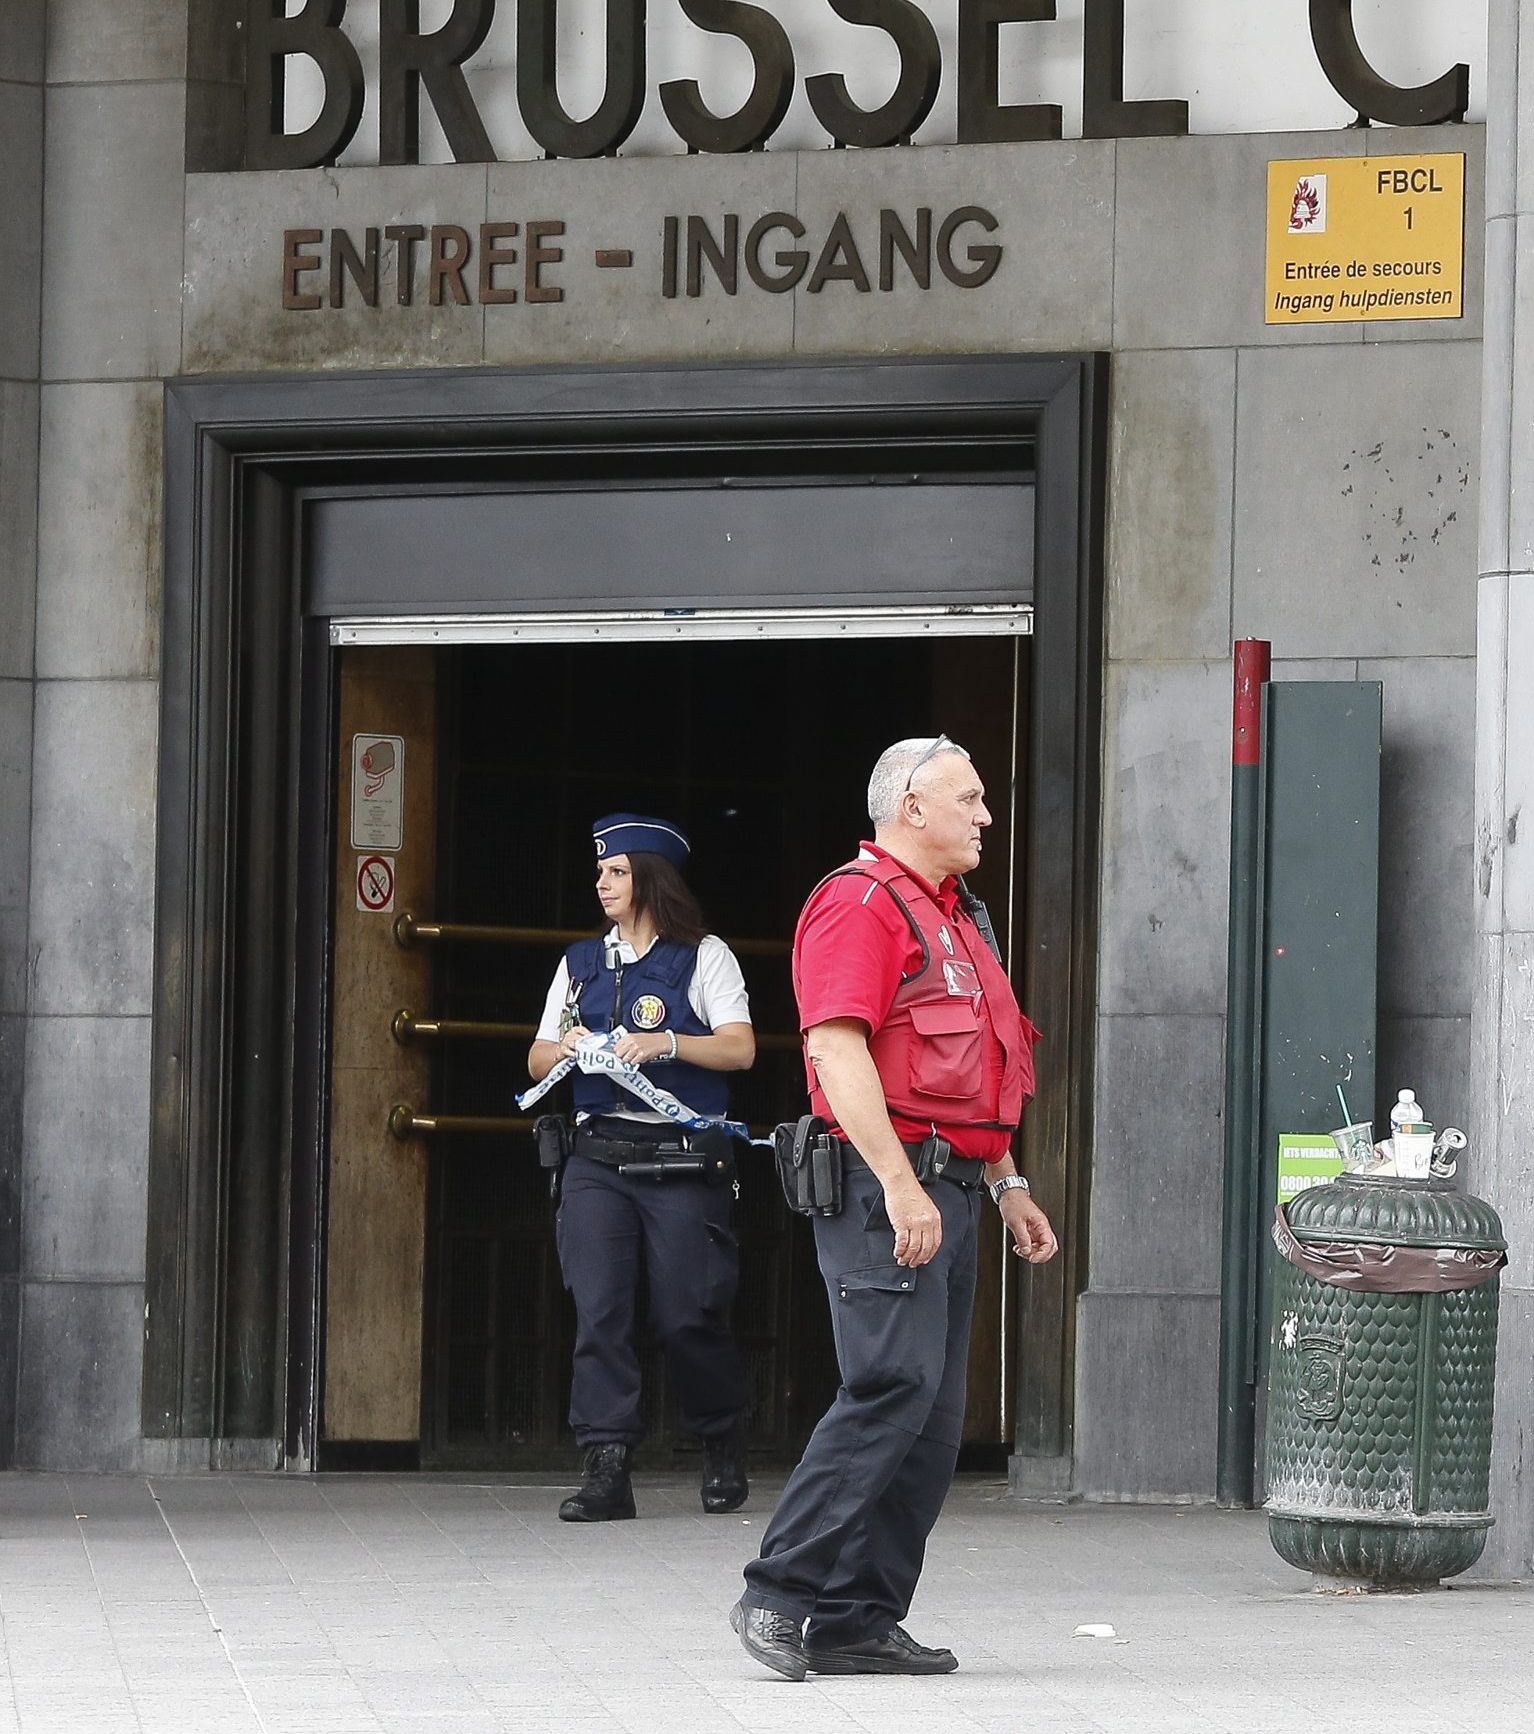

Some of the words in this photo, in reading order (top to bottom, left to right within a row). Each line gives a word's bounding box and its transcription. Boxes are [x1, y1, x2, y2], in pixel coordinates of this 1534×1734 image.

[1377, 169, 1443, 194] FBCL
[1403, 206, 1414, 230] 1
[282, 221, 566, 310] ENTREE
[662, 205, 1003, 298] INGANG
[1285, 260, 1341, 280] Entrée
[1346, 260, 1367, 277] de
[1372, 260, 1442, 277] secours
[1274, 291, 1335, 314] Ingang
[1339, 288, 1453, 312] hulpdiensten
[1280, 1175, 1312, 1192] 0800
